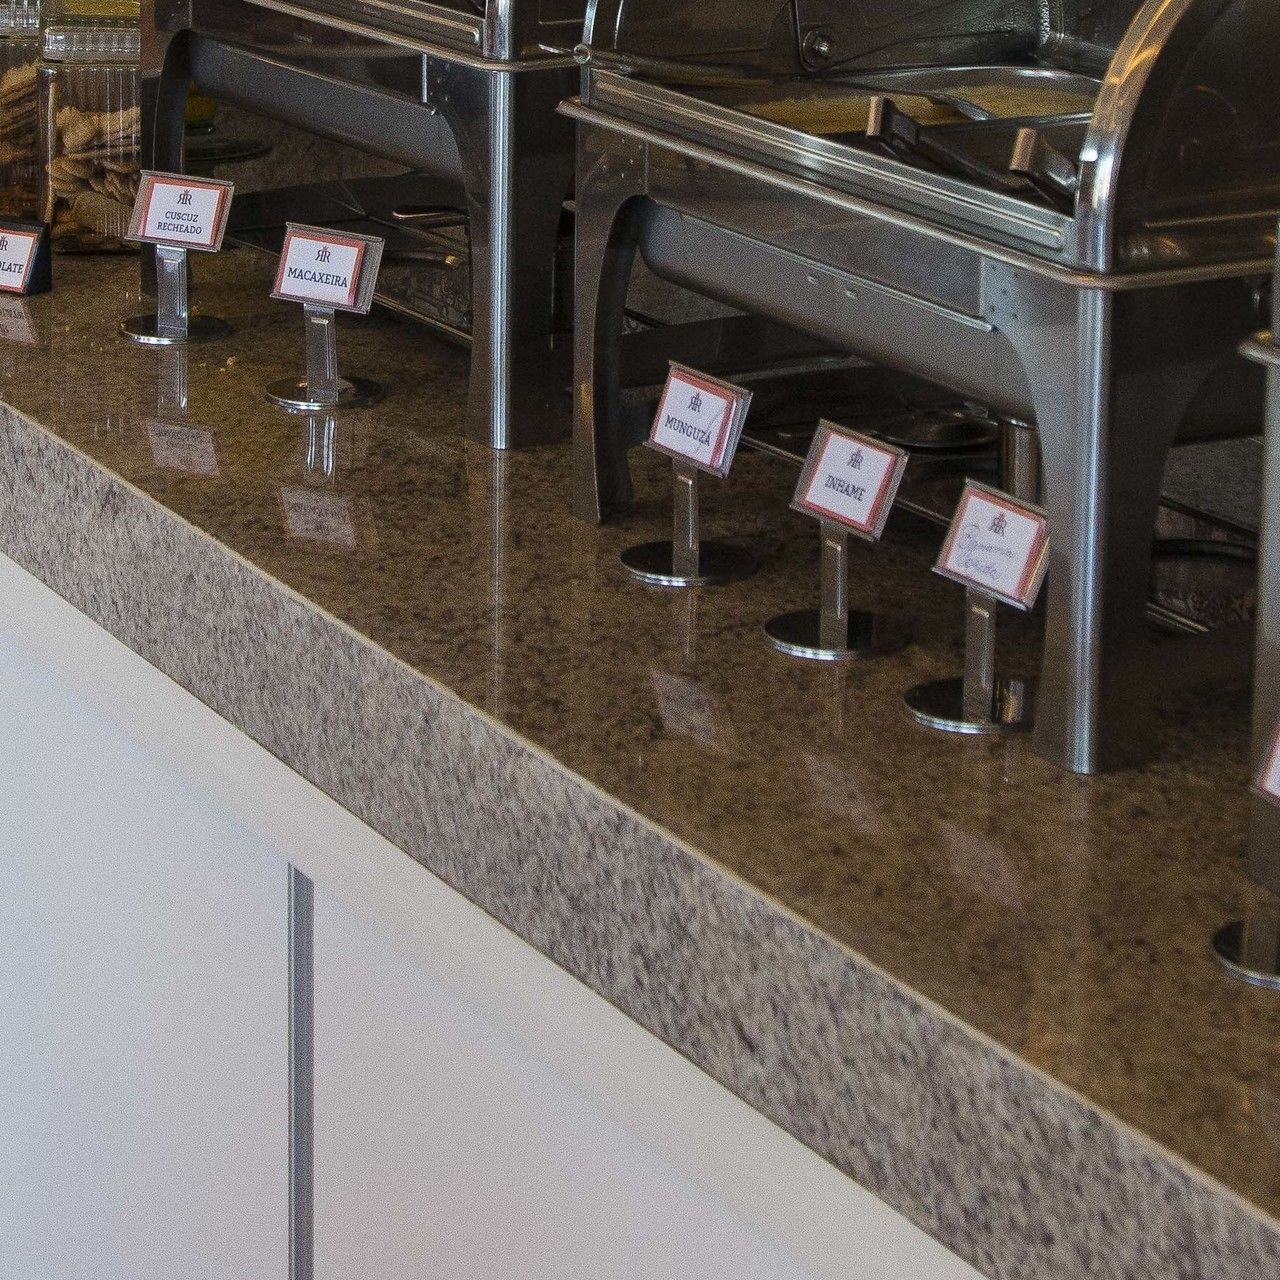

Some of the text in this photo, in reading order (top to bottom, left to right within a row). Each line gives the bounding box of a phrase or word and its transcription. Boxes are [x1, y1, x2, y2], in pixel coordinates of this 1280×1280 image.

[165, 211, 199, 223] CUSCUZ
[157, 222, 202, 234] RECHEADO
[287, 267, 348, 288] MACAXEIRA
[825, 475, 866, 500] INHAME
